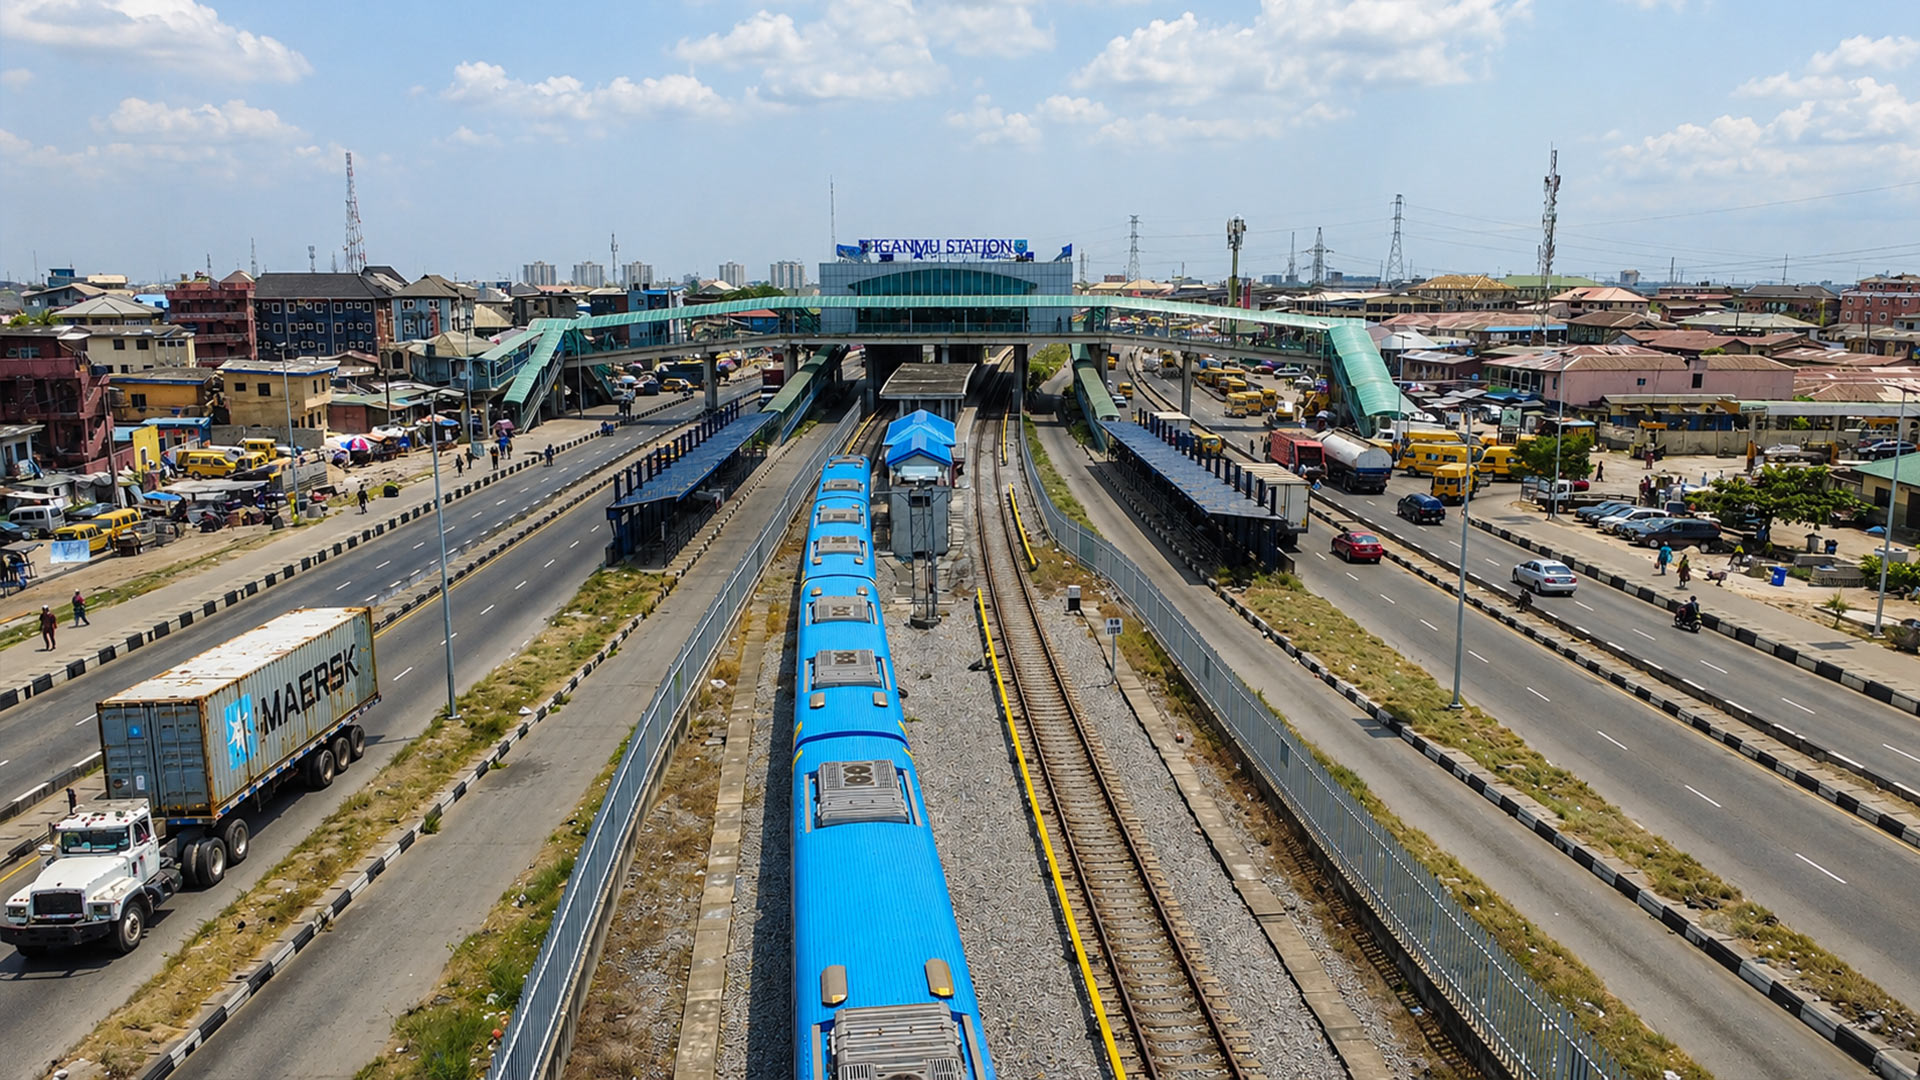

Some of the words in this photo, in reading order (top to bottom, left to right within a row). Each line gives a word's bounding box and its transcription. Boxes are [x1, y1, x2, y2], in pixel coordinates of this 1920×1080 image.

[873, 239, 940, 254] IGANMU
[946, 239, 1013, 254] STATION
[260, 644, 359, 736] MAERSK
